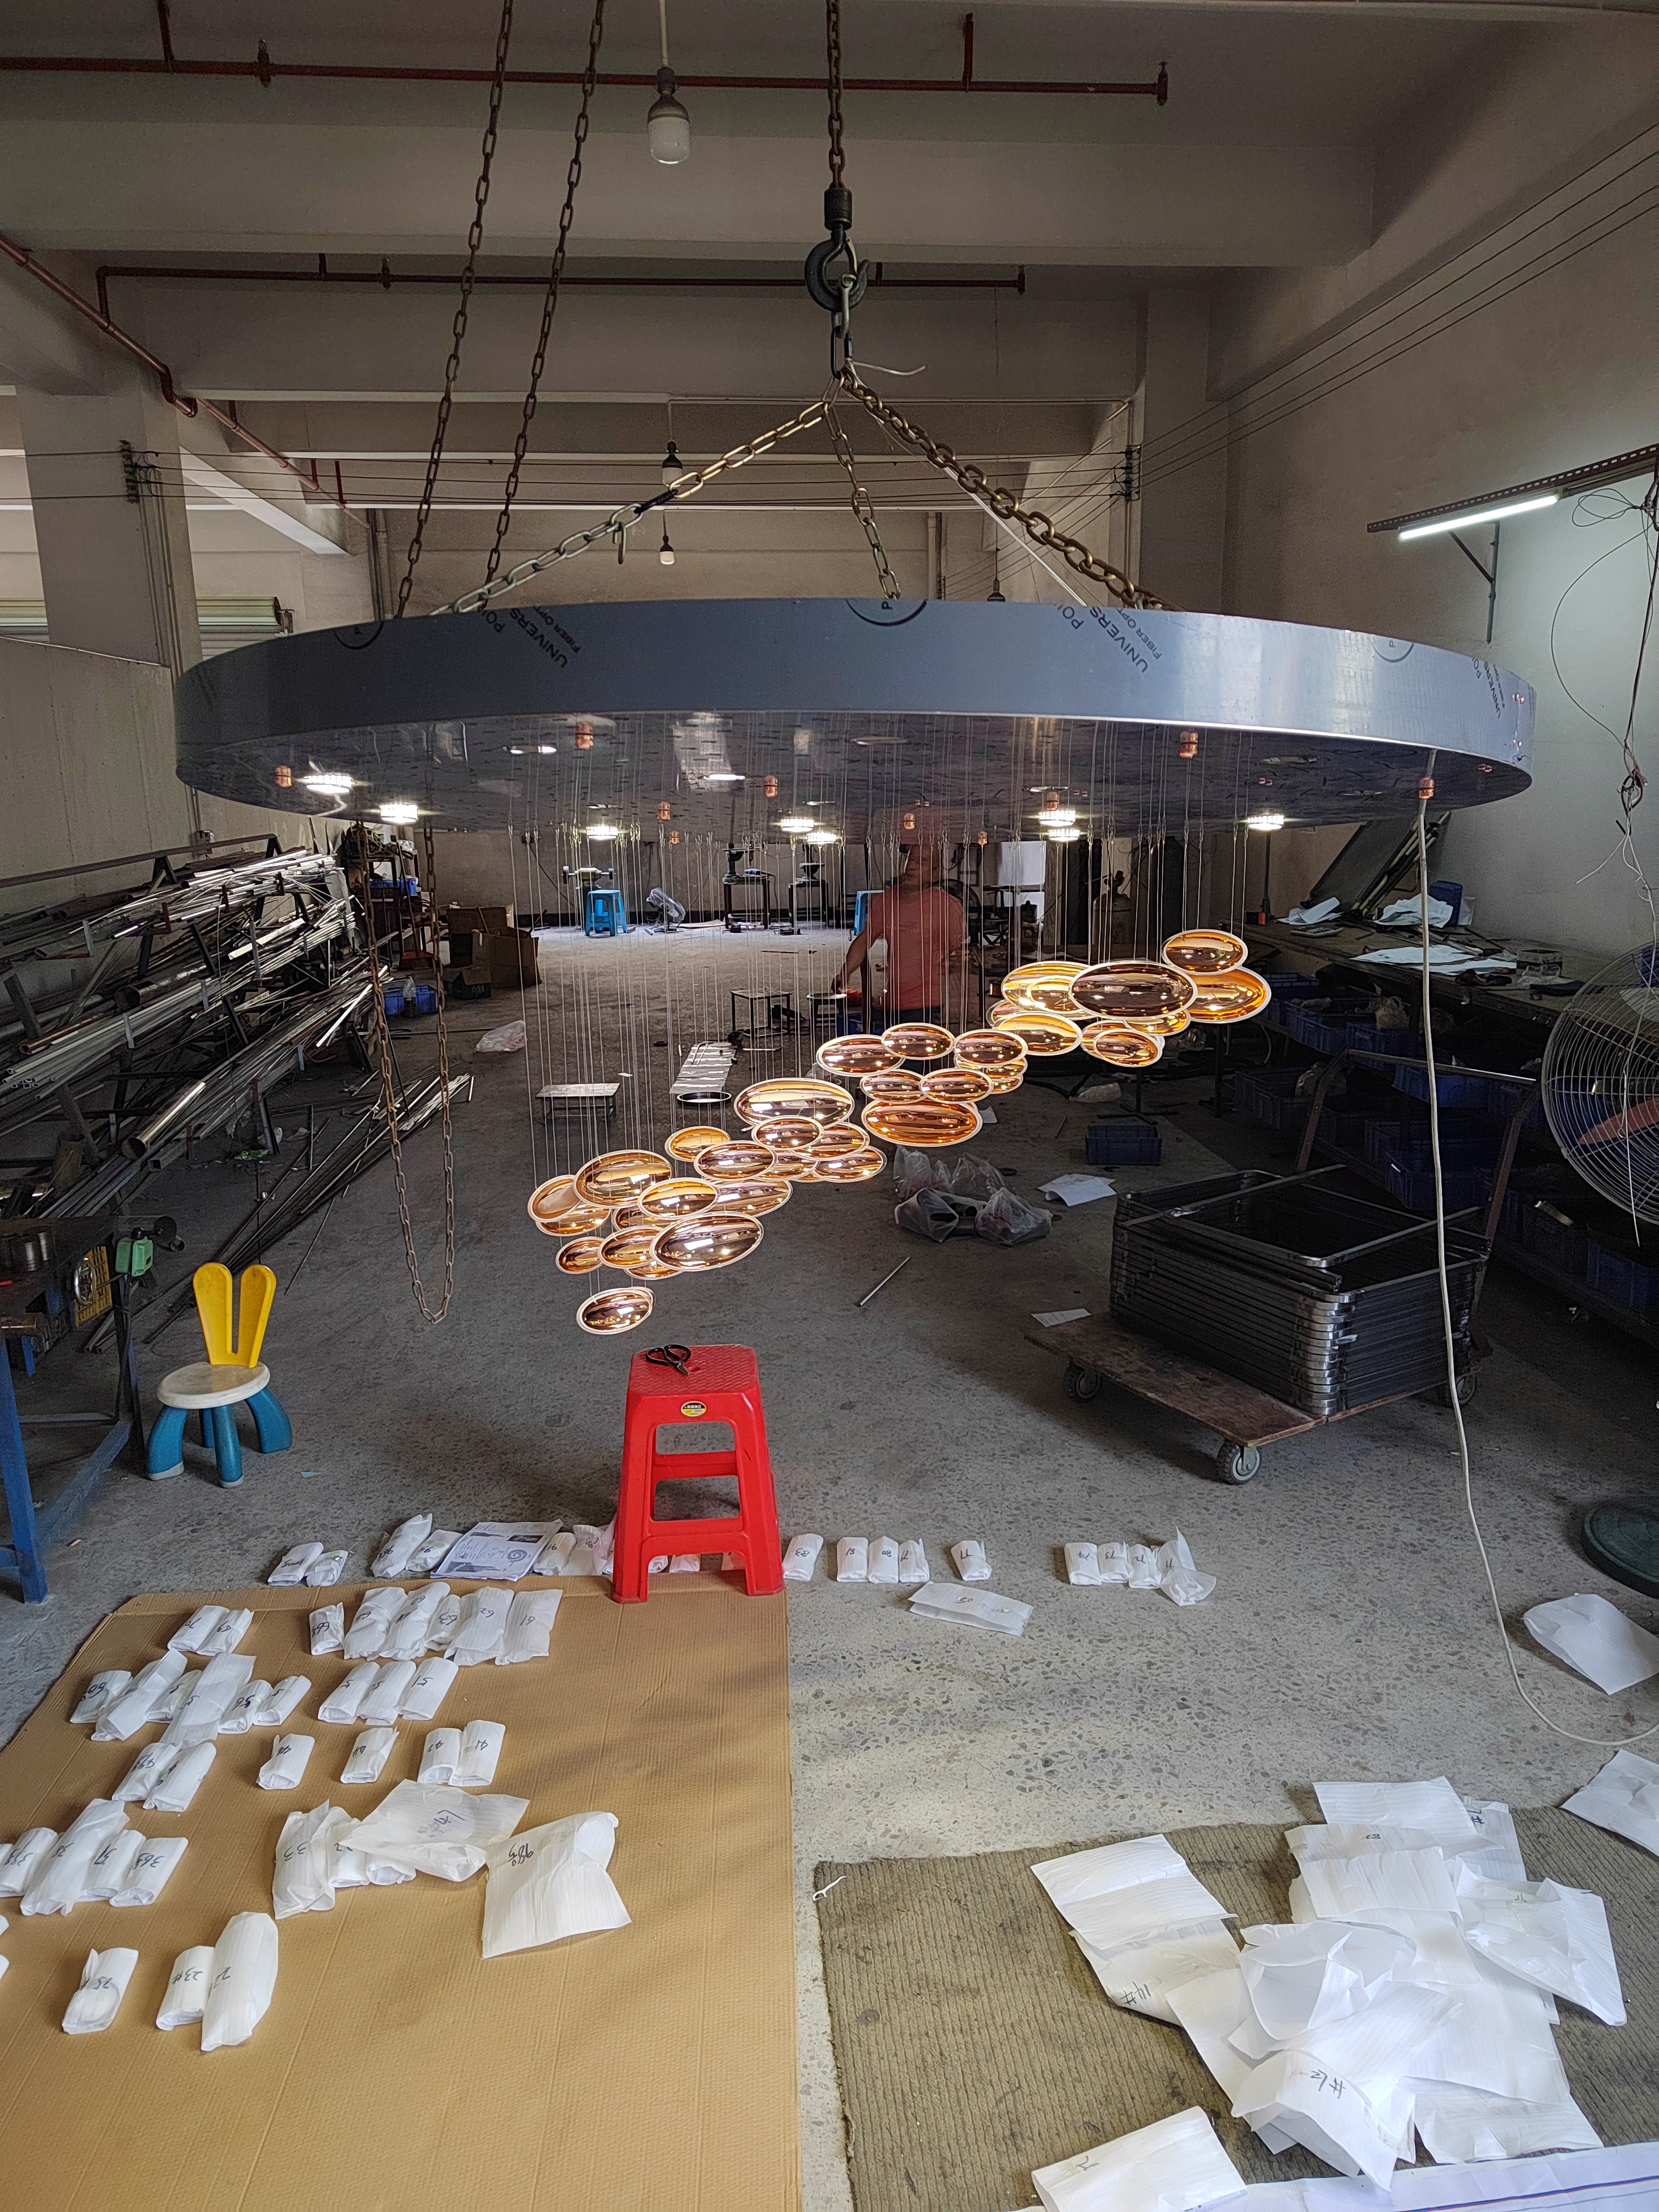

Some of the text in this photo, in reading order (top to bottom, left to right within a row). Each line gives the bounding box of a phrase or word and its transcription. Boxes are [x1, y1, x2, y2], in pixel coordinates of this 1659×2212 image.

[881, 601, 893, 610] P
[509, 607, 568, 668] UNIVERS
[1089, 605, 1148, 673] UNIVERS
[1105, 1550, 1116, 1559] 73
[1165, 1558, 1175, 1567] 71
[478, 1607, 495, 1618] 62
[520, 1614, 535, 1626] 61
[411, 1675, 434, 1687] 51
[474, 1739, 489, 1751] 41
[283, 1841, 308, 1861] 33
